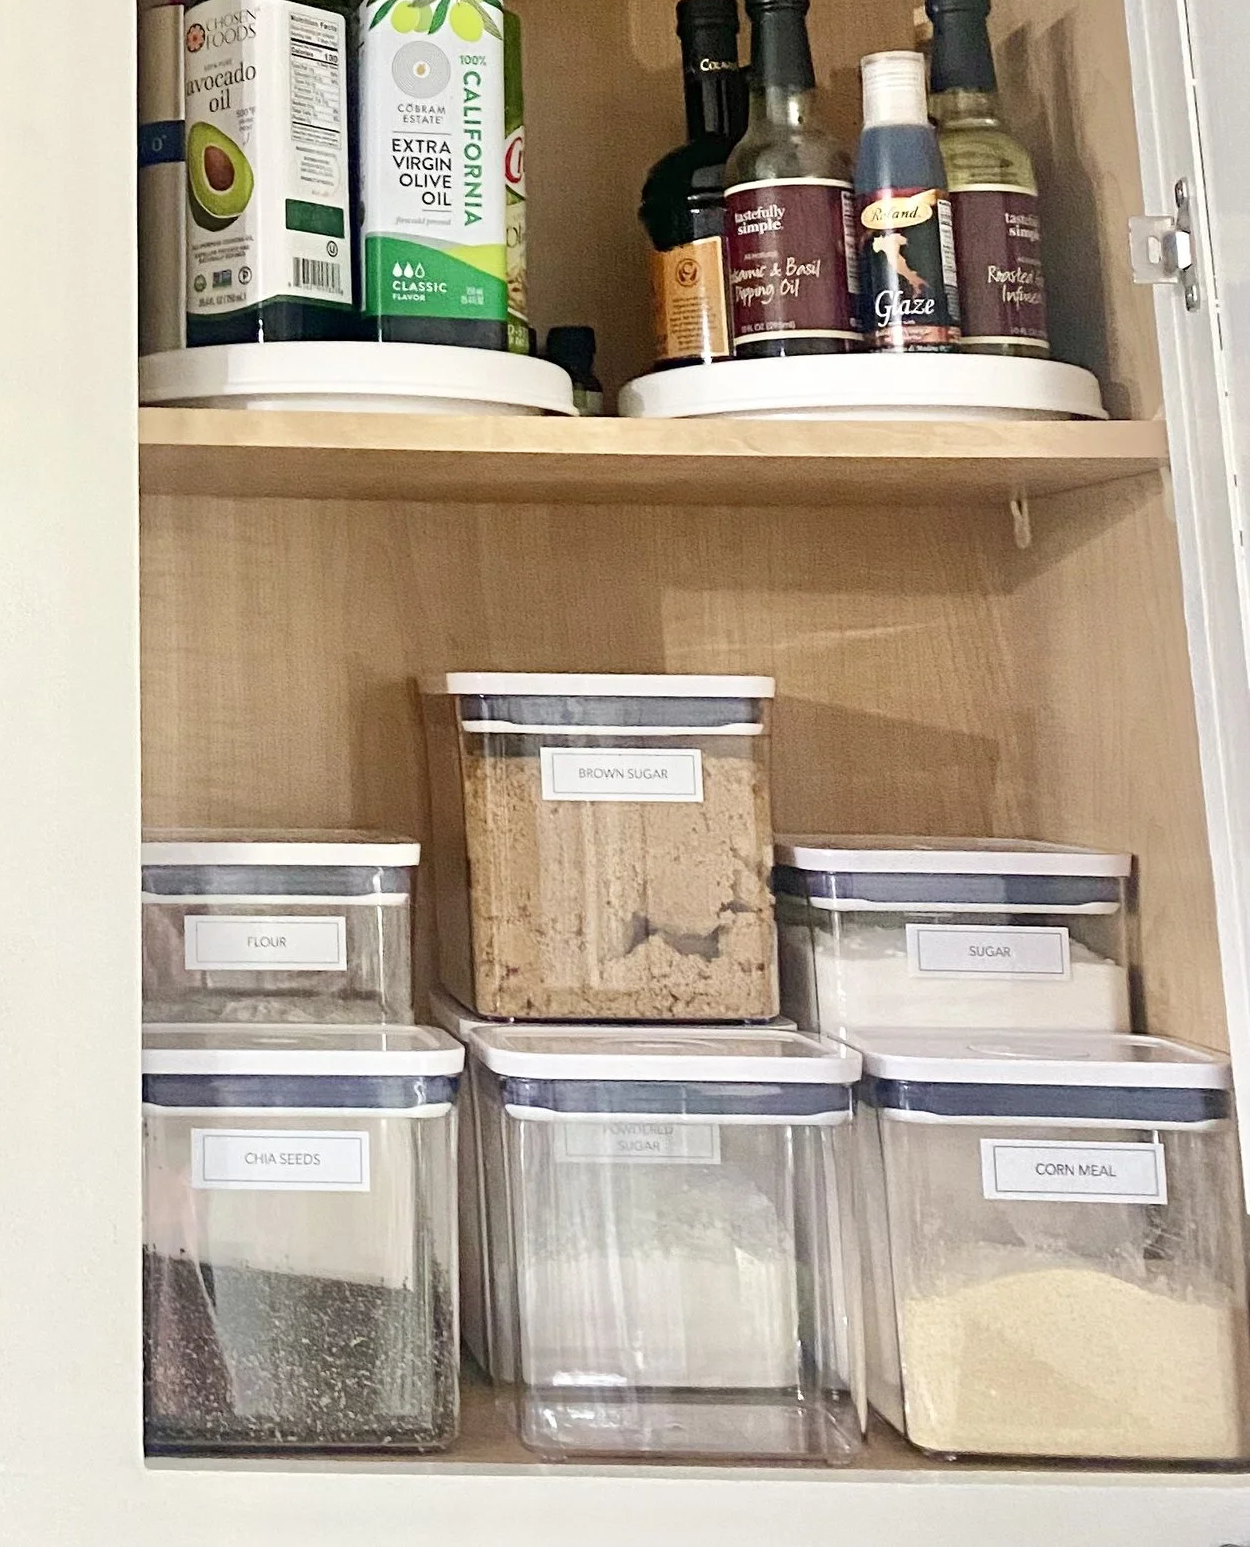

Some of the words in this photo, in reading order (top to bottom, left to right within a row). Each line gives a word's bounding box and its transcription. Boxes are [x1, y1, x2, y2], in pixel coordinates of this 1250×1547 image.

[206, 9, 256, 32] CHOSEN
[206, 24, 256, 50] FOODS
[459, 54, 488, 66] 100%
[186, 61, 257, 97] avocado
[209, 88, 231, 113] oil
[403, 115, 441, 125] ESTATE
[392, 139, 451, 154] EXTRA
[462, 70, 483, 226] CALIFORNIA
[393, 155, 452, 172] VIRGIN
[400, 173, 452, 189] OLIVE
[422, 191, 452, 207] OIL
[734, 204, 786, 223] tastefully
[738, 220, 781, 235] simple
[769, 262, 782, 277] &
[786, 257, 821, 278] Basil
[392, 280, 447, 293] CLASSIC
[780, 278, 800, 297] Oil
[392, 293, 426, 302] FLAVOR
[875, 289, 935, 327] Glaze
[578, 768, 624, 780] BROWN
[627, 768, 668, 780] SUGAR
[247, 936, 287, 948] FLOUR
[968, 945, 1012, 958] SUGAR
[617, 1140, 661, 1152] SUGAR
[244, 1153, 277, 1166] CHIA
[280, 1153, 321, 1166] SEEDS
[1035, 1163, 1074, 1177] CORN
[1078, 1163, 1117, 1177] MEAL
